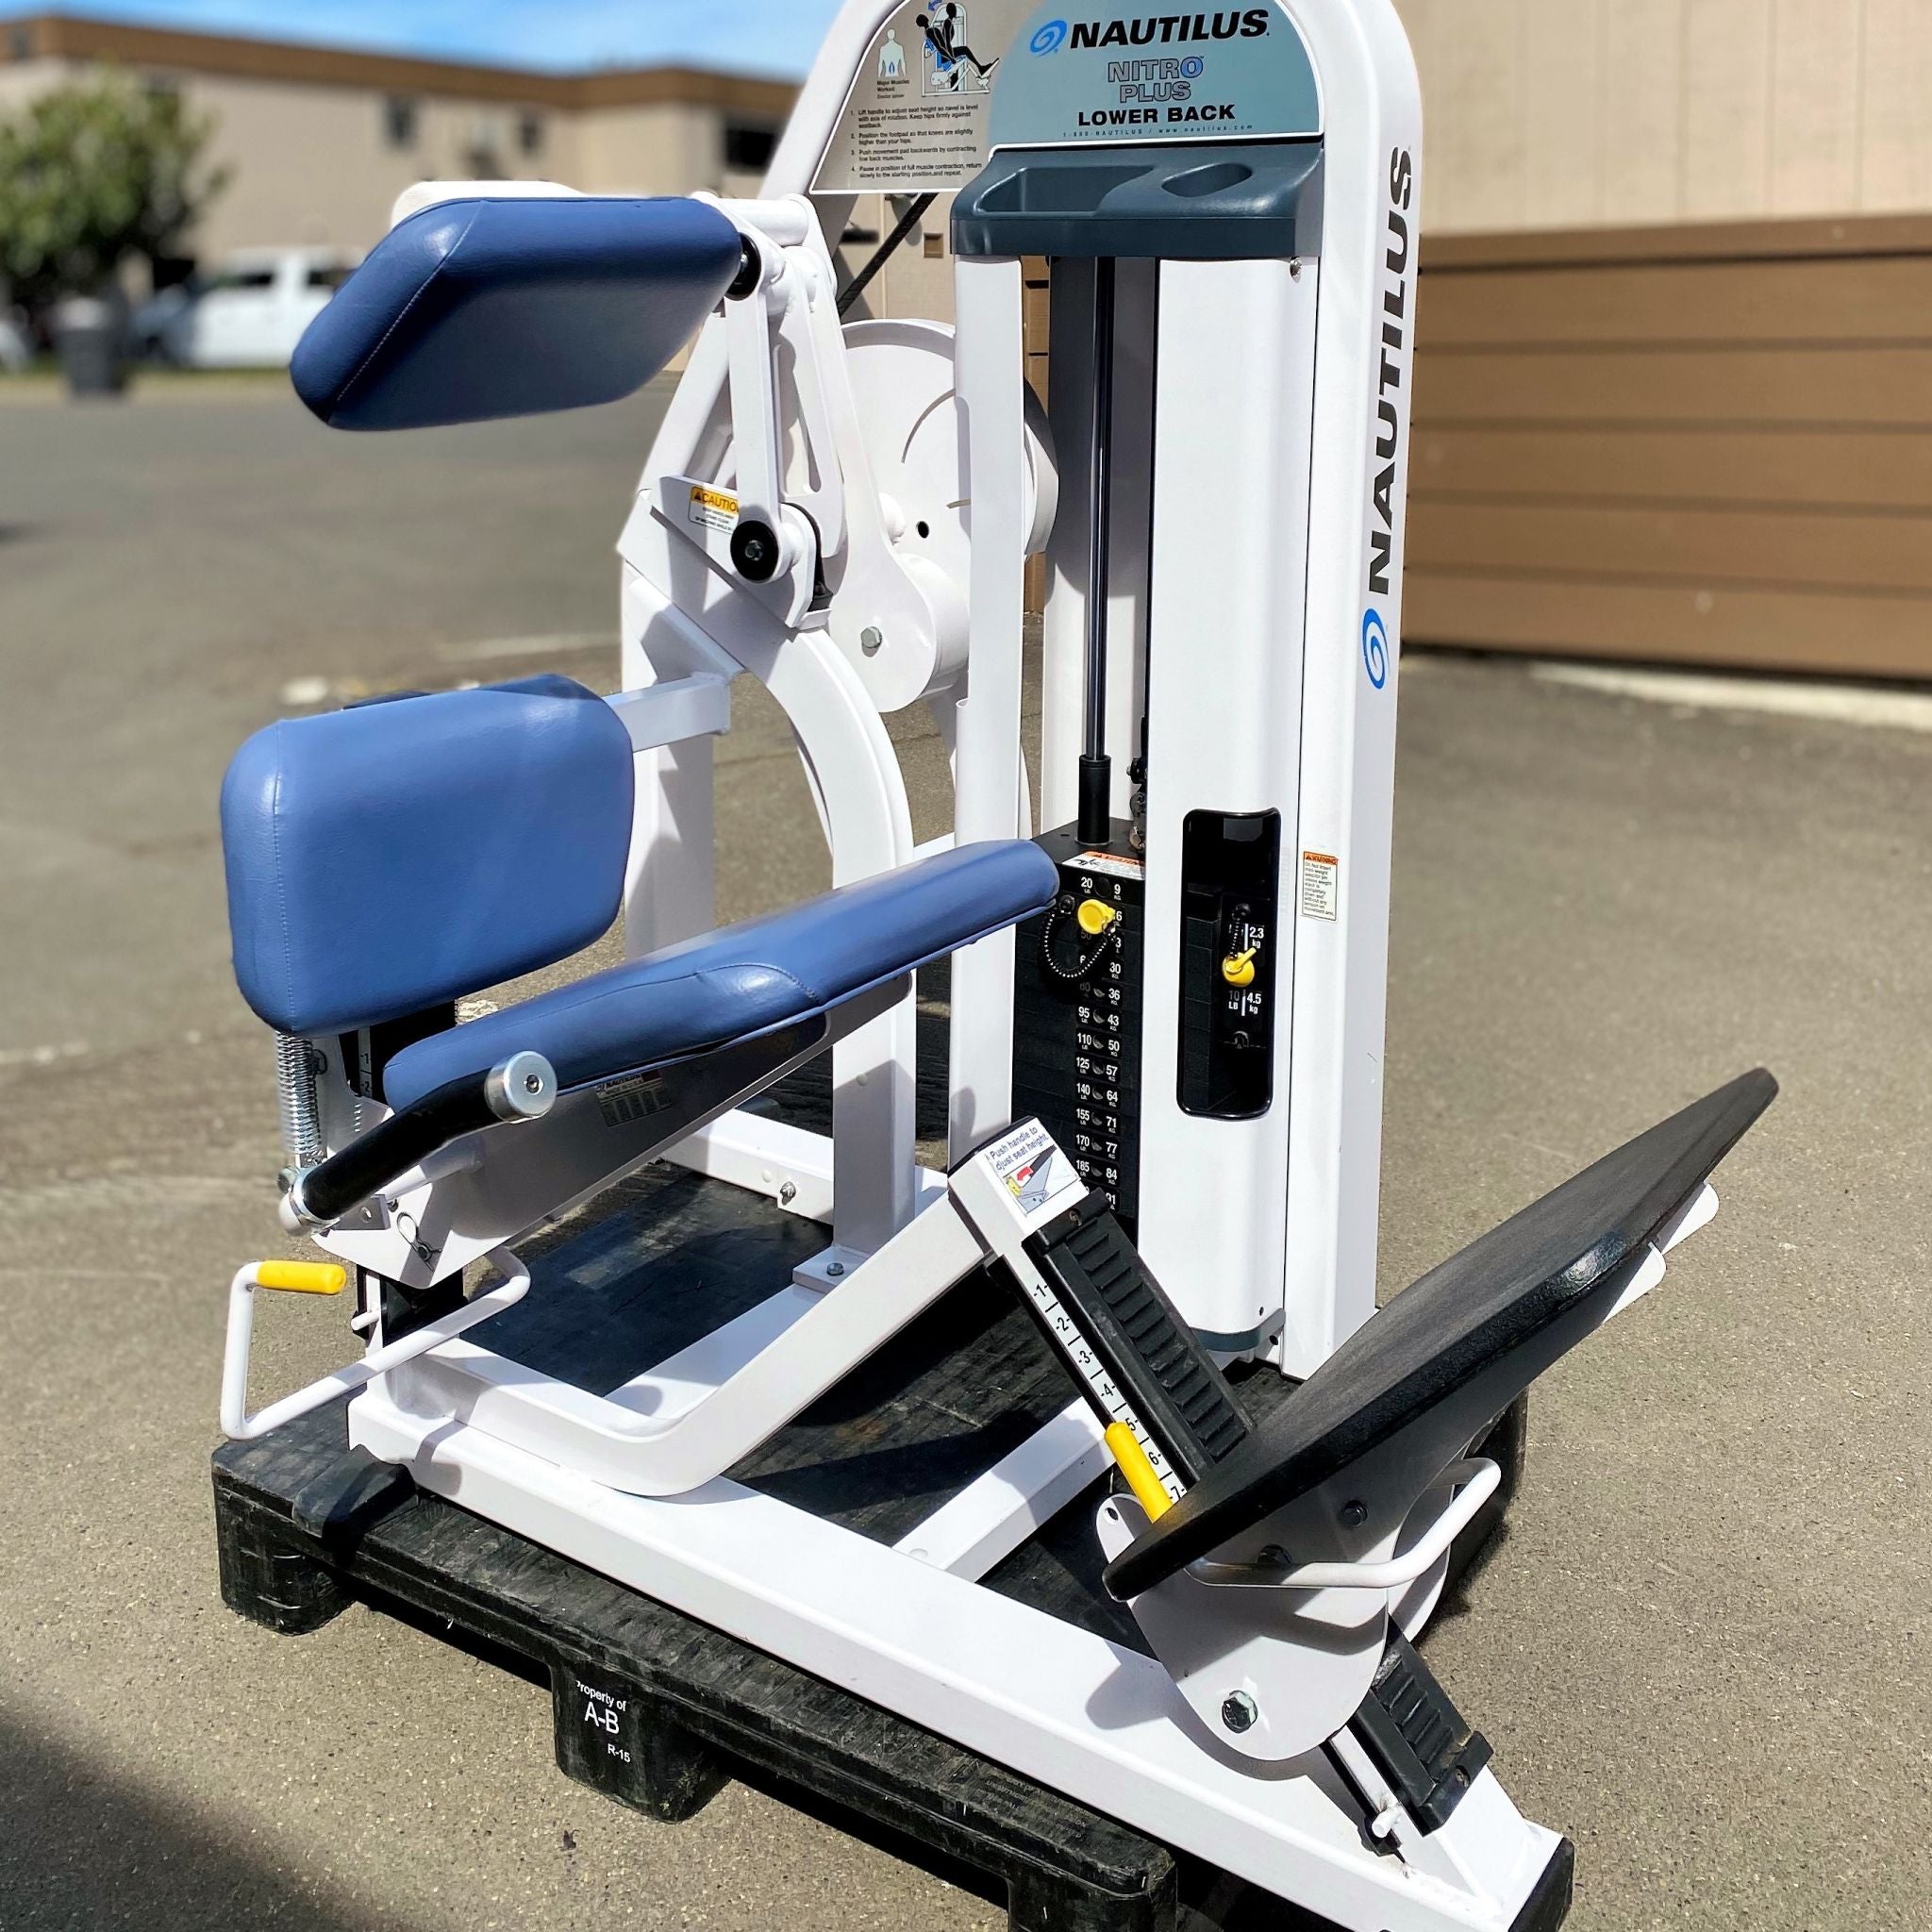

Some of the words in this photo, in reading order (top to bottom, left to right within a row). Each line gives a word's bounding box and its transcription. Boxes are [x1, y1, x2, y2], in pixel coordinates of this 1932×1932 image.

[1070, 8, 1270, 49] NAUTILUS
[1108, 57, 1204, 82] NITRO
[1120, 81, 1191, 103] PLUS
[1078, 108, 1158, 126] LOWER
[1167, 104, 1236, 123] BACK
[1368, 146, 1412, 596] NAUTILUS
[702, 492, 739, 513] CAUTIO
[1080, 876, 1092, 889] 20
[1114, 883, 1121, 895] 9
[1249, 926, 1265, 939] 2.3
[1252, 939, 1261, 949] kg
[1109, 962, 1121, 974] 30
[1108, 988, 1121, 1001] 36
[1228, 990, 1241, 1001] 10
[1246, 991, 1262, 1005] 4.5
[1078, 1006, 1091, 1019] 95
[1107, 1014, 1120, 1027] 43
[1228, 1001, 1239, 1009] LB
[1249, 1004, 1258, 1014] kg
[1076, 1032, 1092, 1046] 110
[1108, 1039, 1120, 1052] 50
[1075, 1057, 1090, 1070] 125
[1106, 1064, 1118, 1076] 57
[1076, 1082, 1091, 1095] 140
[1106, 1090, 1119, 1103] 64
[1075, 1108, 1091, 1122] 155
[1106, 1115, 1117, 1128] 71
[990, 1144, 1008, 1159] Push
[1007, 1132, 1030, 1148] handle
[1029, 1126, 1038, 1135] to
[1012, 1145, 1028, 1159] seat
[1025, 1133, 1049, 1150] height
[1075, 1134, 1090, 1147] 170
[1106, 1141, 1118, 1154] 77
[1075, 1159, 1090, 1173] 185
[1106, 1167, 1118, 1180] 84
[616, 1700, 626, 1712] of
[584, 1701, 619, 1734] A-B
